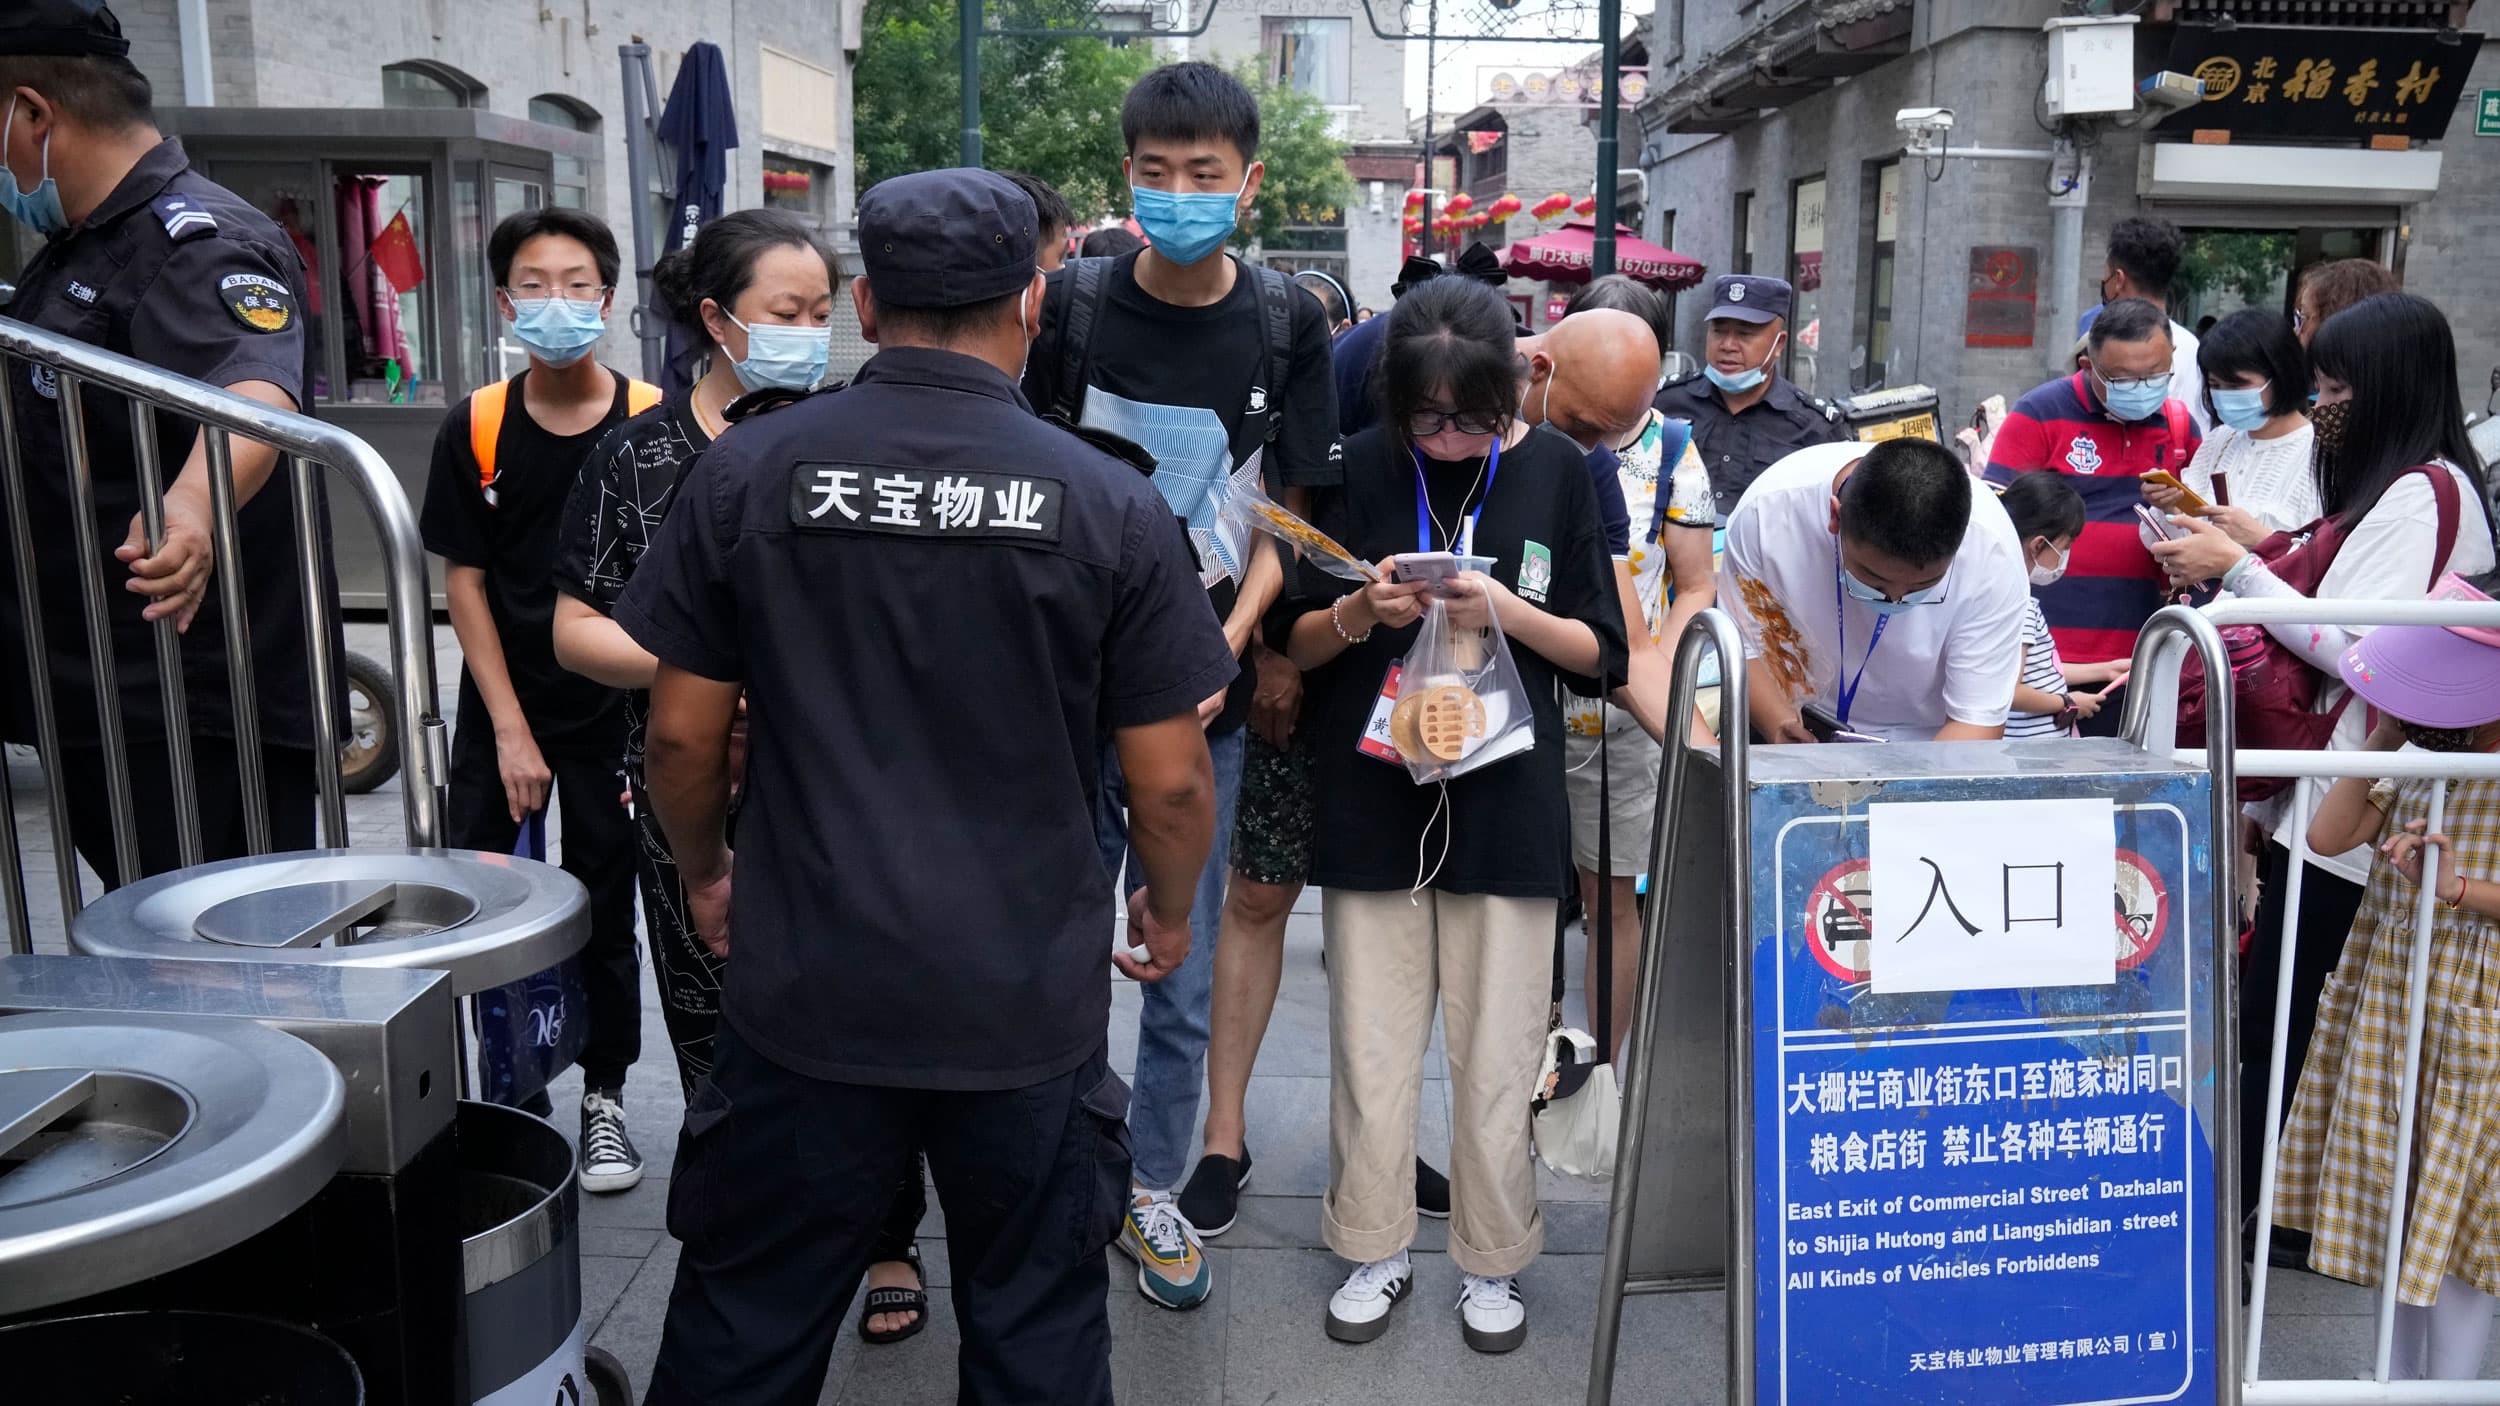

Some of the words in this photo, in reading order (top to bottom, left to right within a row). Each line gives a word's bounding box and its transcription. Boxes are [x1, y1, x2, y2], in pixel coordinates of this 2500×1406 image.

[2243, 56, 2278, 104] 北京
[2282, 58, 2440, 106] 稻香村
[228, 276, 280, 290] BAOAN
[244, 296, 283, 310] 保安
[808, 470, 1046, 531] 天宝物业
[1896, 856, 2064, 943] 入口
[1788, 1053, 2182, 1116] 大栅栏商业街东口至施家胡同口
[1811, 1128, 1927, 1175] 粮食店街
[1943, 1112, 2165, 1167] 禁止各种车辆通行
[1788, 1202, 1832, 1221] East
[1839, 1198, 1877, 1217] Exit
[1884, 1196, 1904, 1214] of
[1910, 1188, 2024, 1213] Commercial
[2031, 1184, 2089, 1203] Street
[2101, 1178, 2183, 1200] Dazhalan
[1788, 1239, 1808, 1255] to
[1815, 1234, 1869, 1257] Shijia
[1876, 1230, 1946, 1254] Hutong
[1952, 1225, 1987, 1244] and
[1993, 1216, 2112, 1244] Liangshidian
[2123, 1211, 2178, 1230] street
[1788, 1272, 1814, 1290] All
[1821, 1268, 1876, 1287] Kinds
[1883, 1265, 1902, 1283] of
[1908, 1258, 1991, 1281] Vehicles
[1997, 1252, 2100, 1274] Forbiddens
[871, 1291, 916, 1306] DIOR
